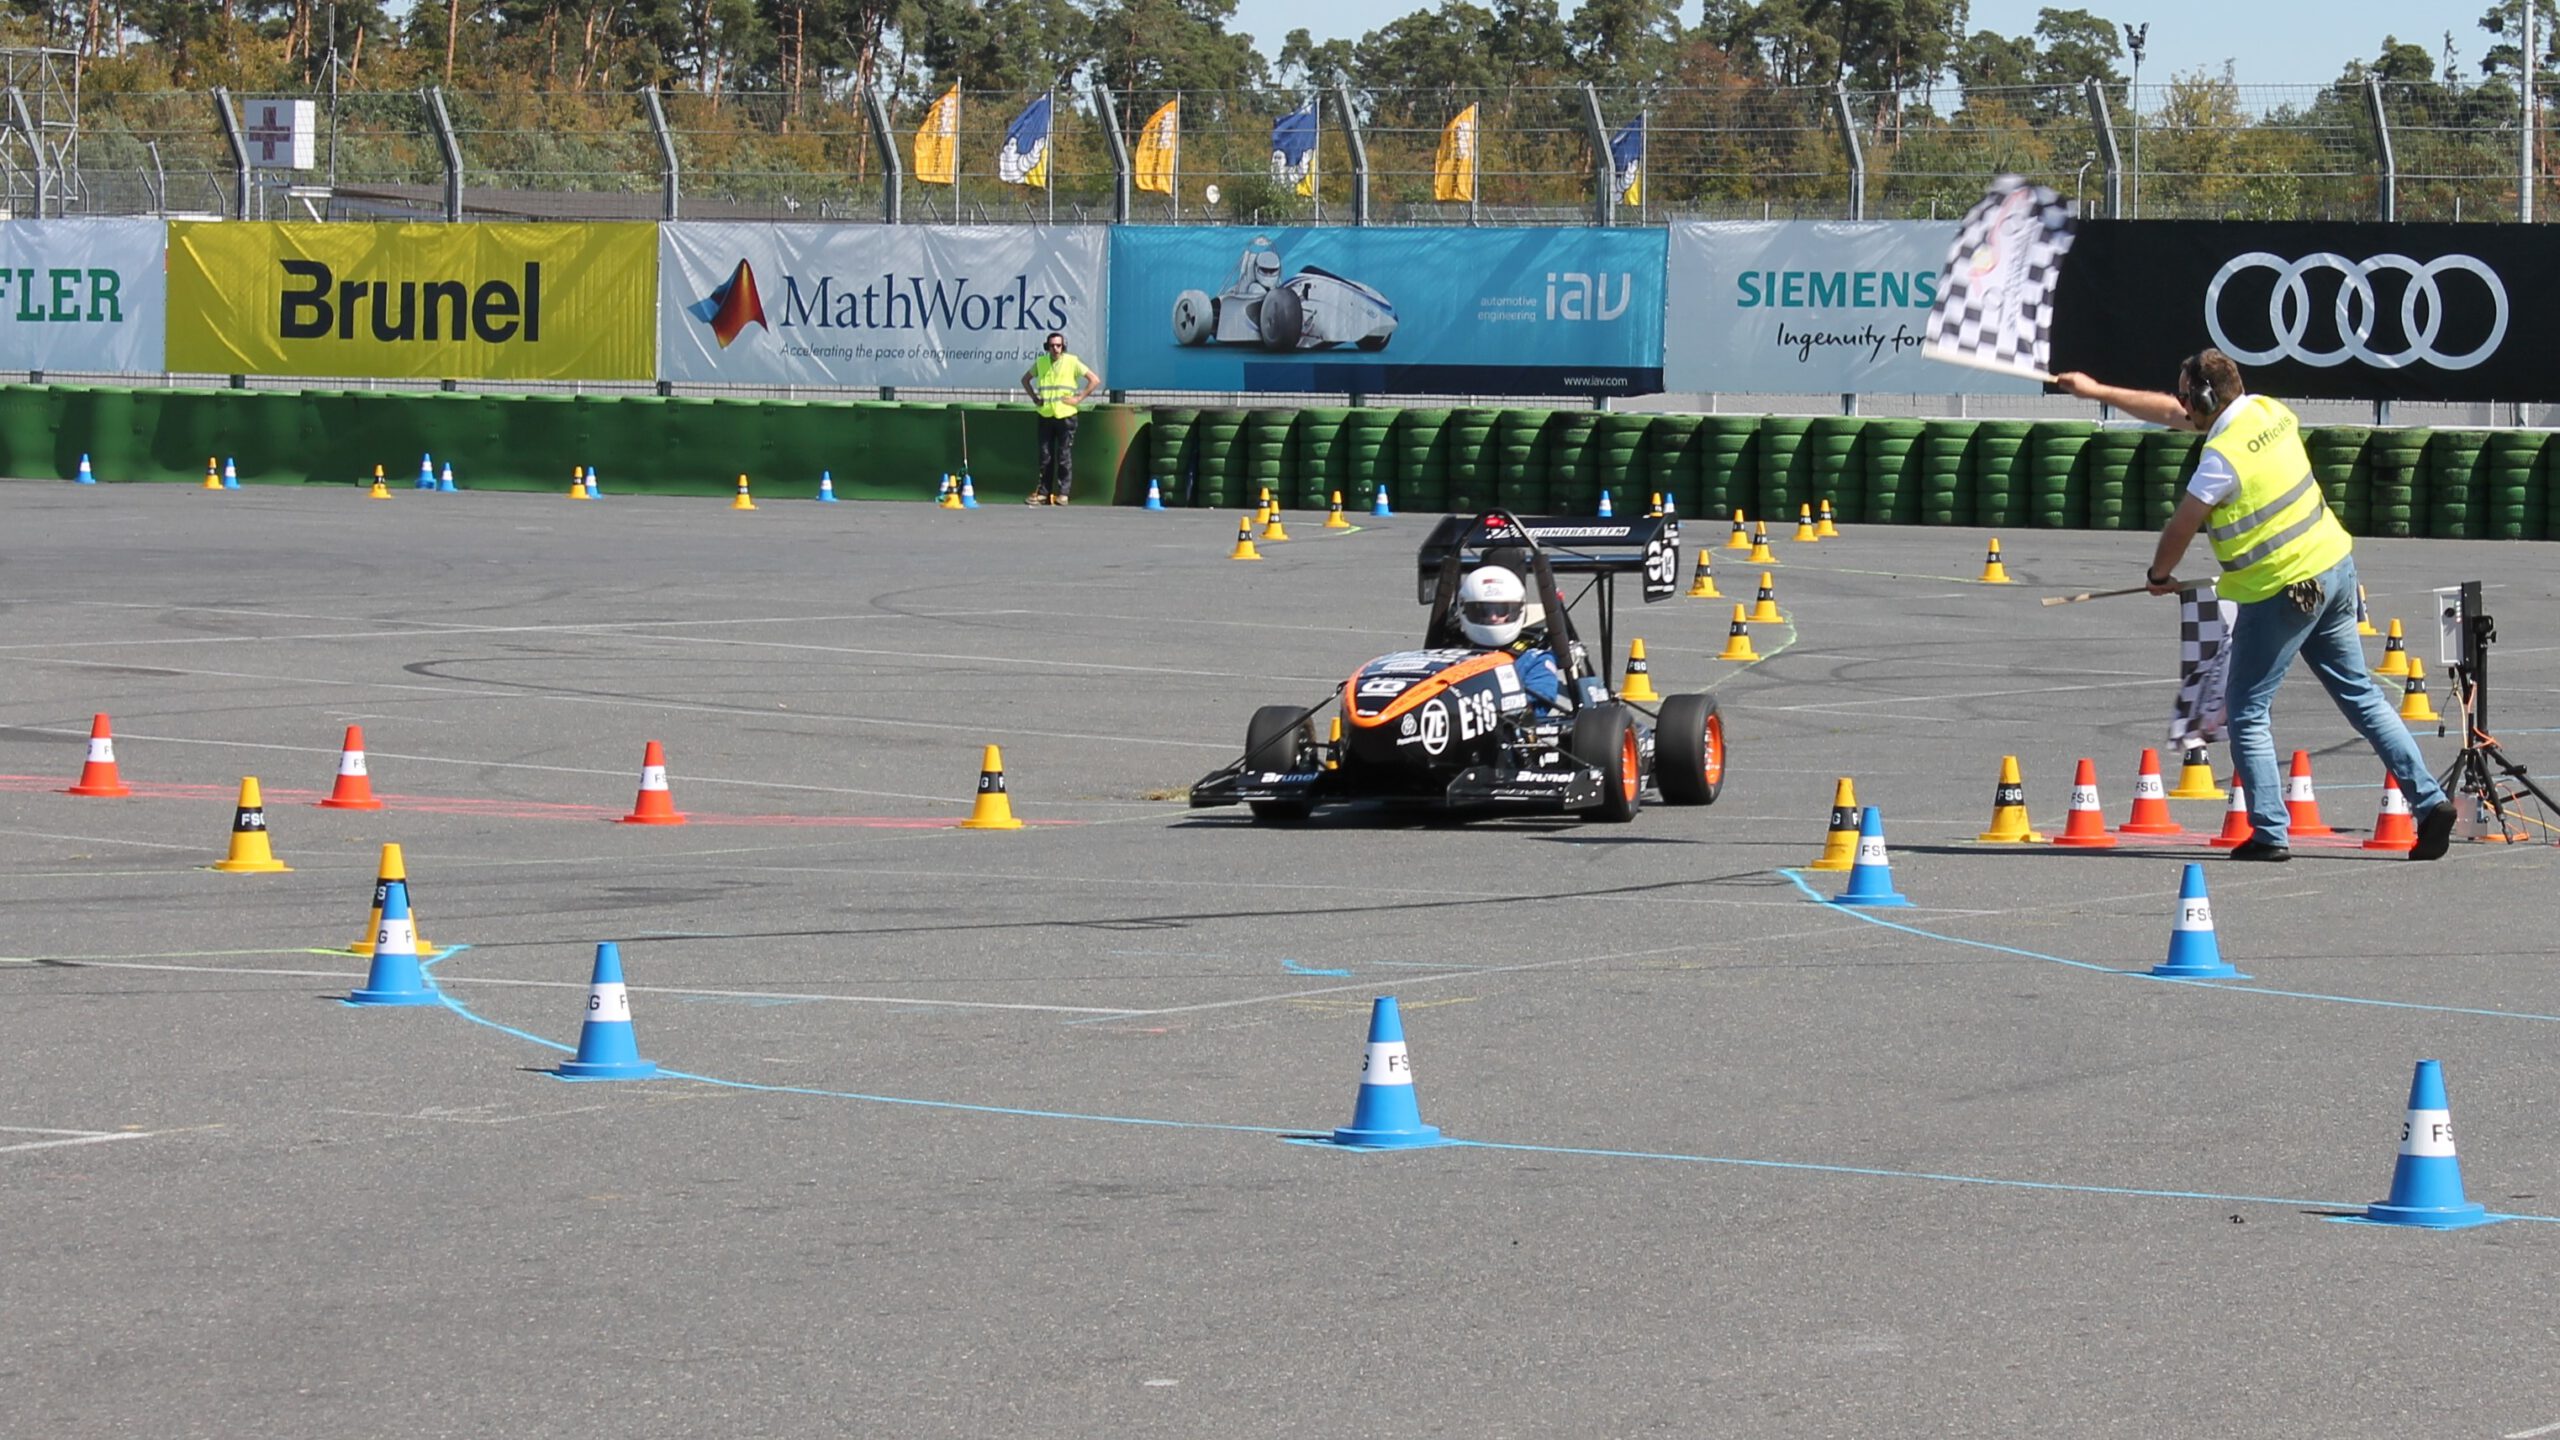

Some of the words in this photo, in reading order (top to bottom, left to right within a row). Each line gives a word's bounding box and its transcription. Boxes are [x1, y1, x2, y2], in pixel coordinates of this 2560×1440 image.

[1737, 271, 1937, 308] SIEMENS
[279, 260, 540, 342] Brunel
[780, 273, 1069, 331] MathWorks
[1480, 296, 1537, 307] automotive
[1478, 311, 1537, 323] engineering
[1777, 322, 1886, 363] Ingenuity
[1891, 324, 1926, 353] for
[780, 342, 853, 362] Accelerating
[855, 343, 873, 358] the
[875, 348, 905, 362] pace
[907, 344, 921, 358] of
[922, 347, 992, 363] engineering
[995, 347, 1020, 360] and
[1564, 375, 1629, 387] www.iav.com
[1458, 689, 1498, 741] E16
[1261, 772, 1319, 783] Brunel
[1516, 770, 1577, 783] Brunel
[1998, 788, 2023, 801] FSG
[2071, 793, 2095, 803] FSG
